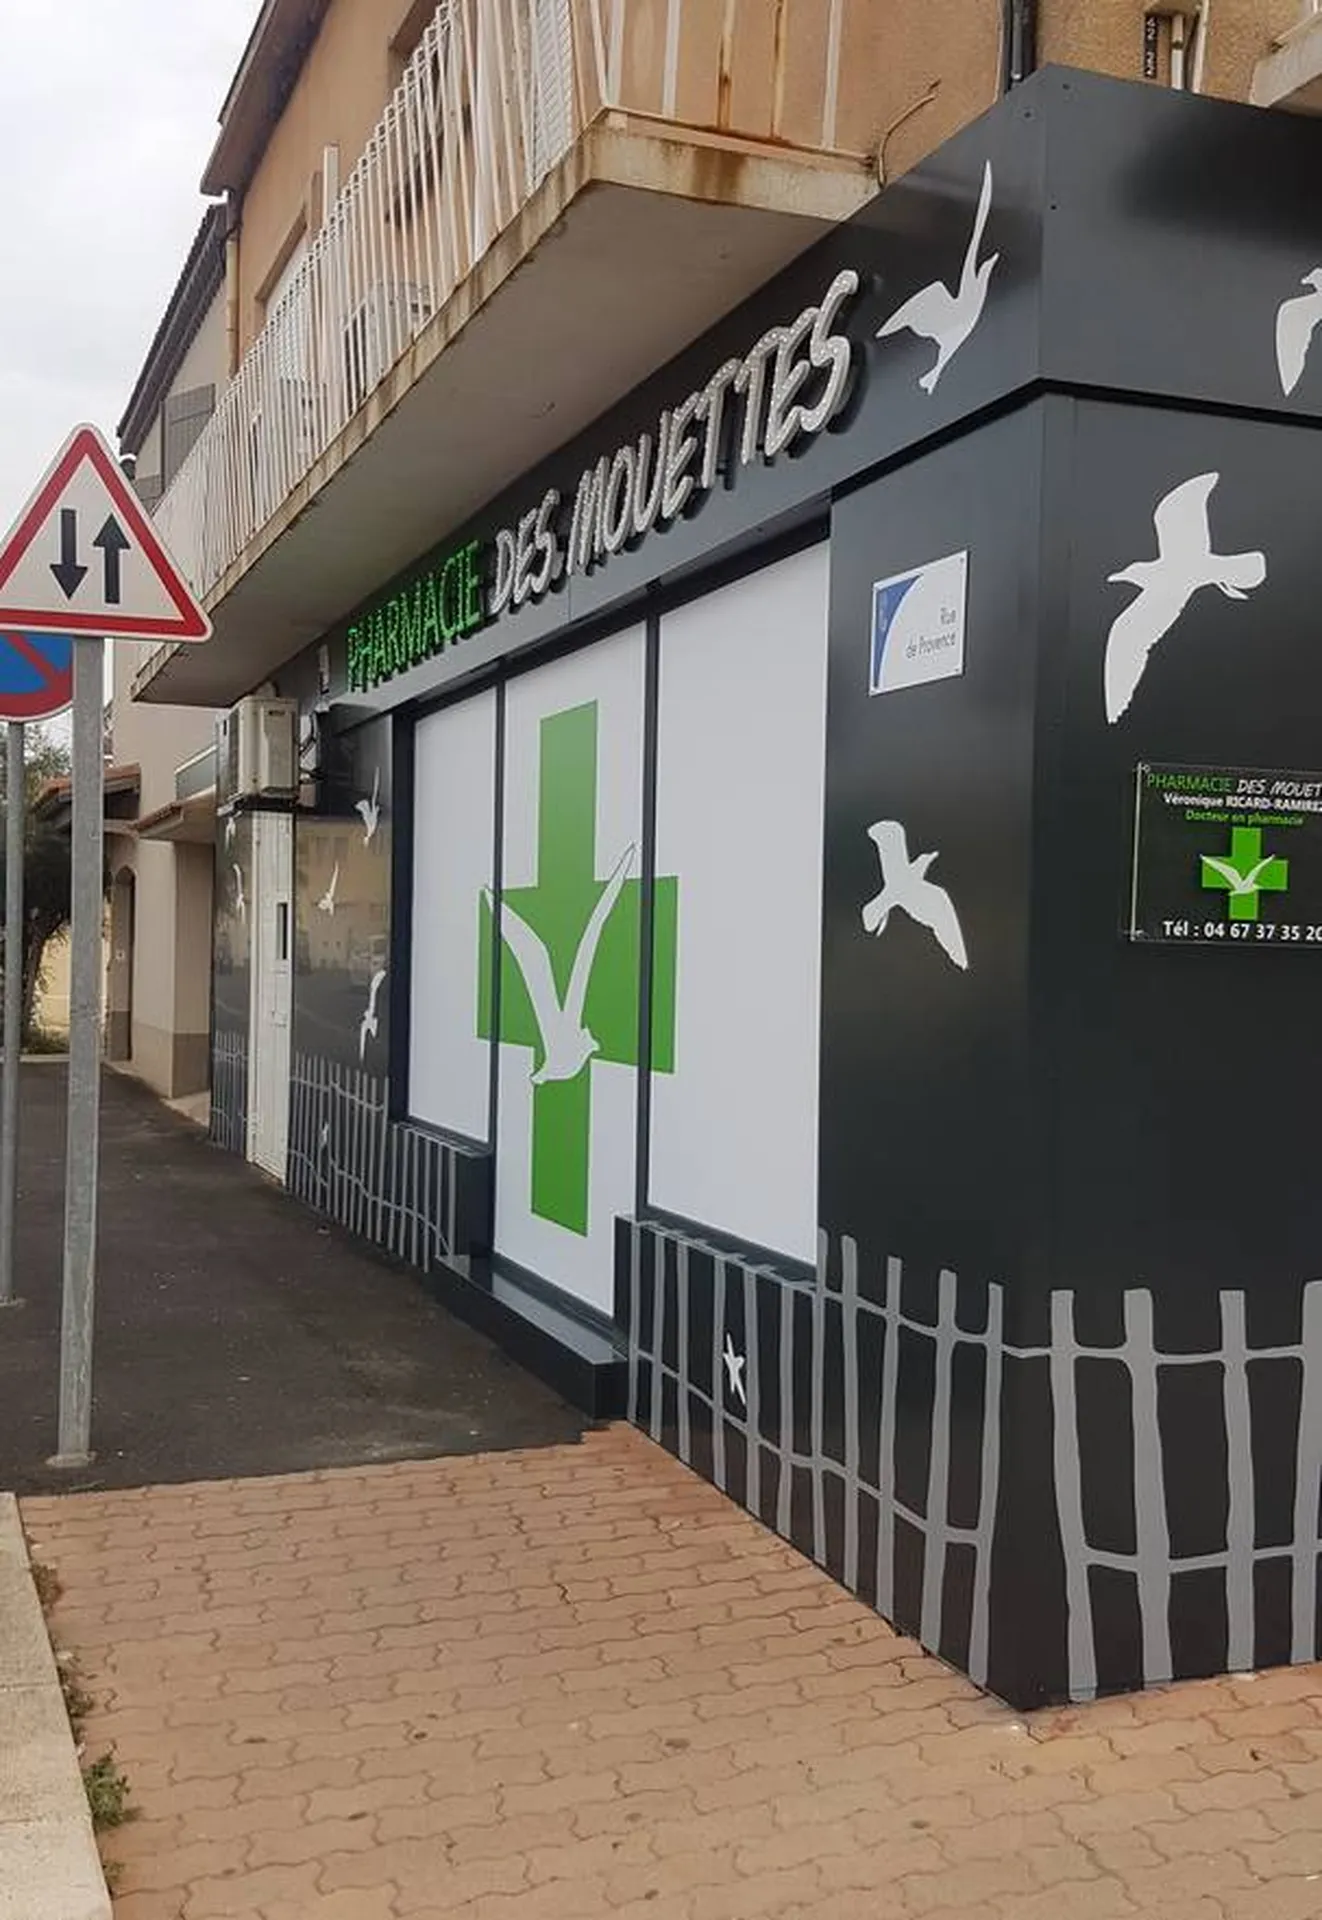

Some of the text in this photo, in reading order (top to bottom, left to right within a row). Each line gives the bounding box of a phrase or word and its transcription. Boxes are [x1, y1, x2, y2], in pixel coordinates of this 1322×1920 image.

[348, 269, 859, 690] PHARMACIE DES MOUETTES
[940, 607, 956, 625] Rue
[906, 632, 956, 659] de Provence
[1147, 773, 1233, 793] PHARMACIE
[1237, 779, 1267, 794] DES
[1164, 793, 1223, 808] Véronique
[1186, 810, 1303, 826] Docteur en pharmacie
[1163, 920, 1188, 937] Tél
[1204, 923, 1225, 938] 04
[1230, 923, 1250, 939] 67
[1256, 924, 1275, 939] 37
[1281, 925, 1300, 940] 35
